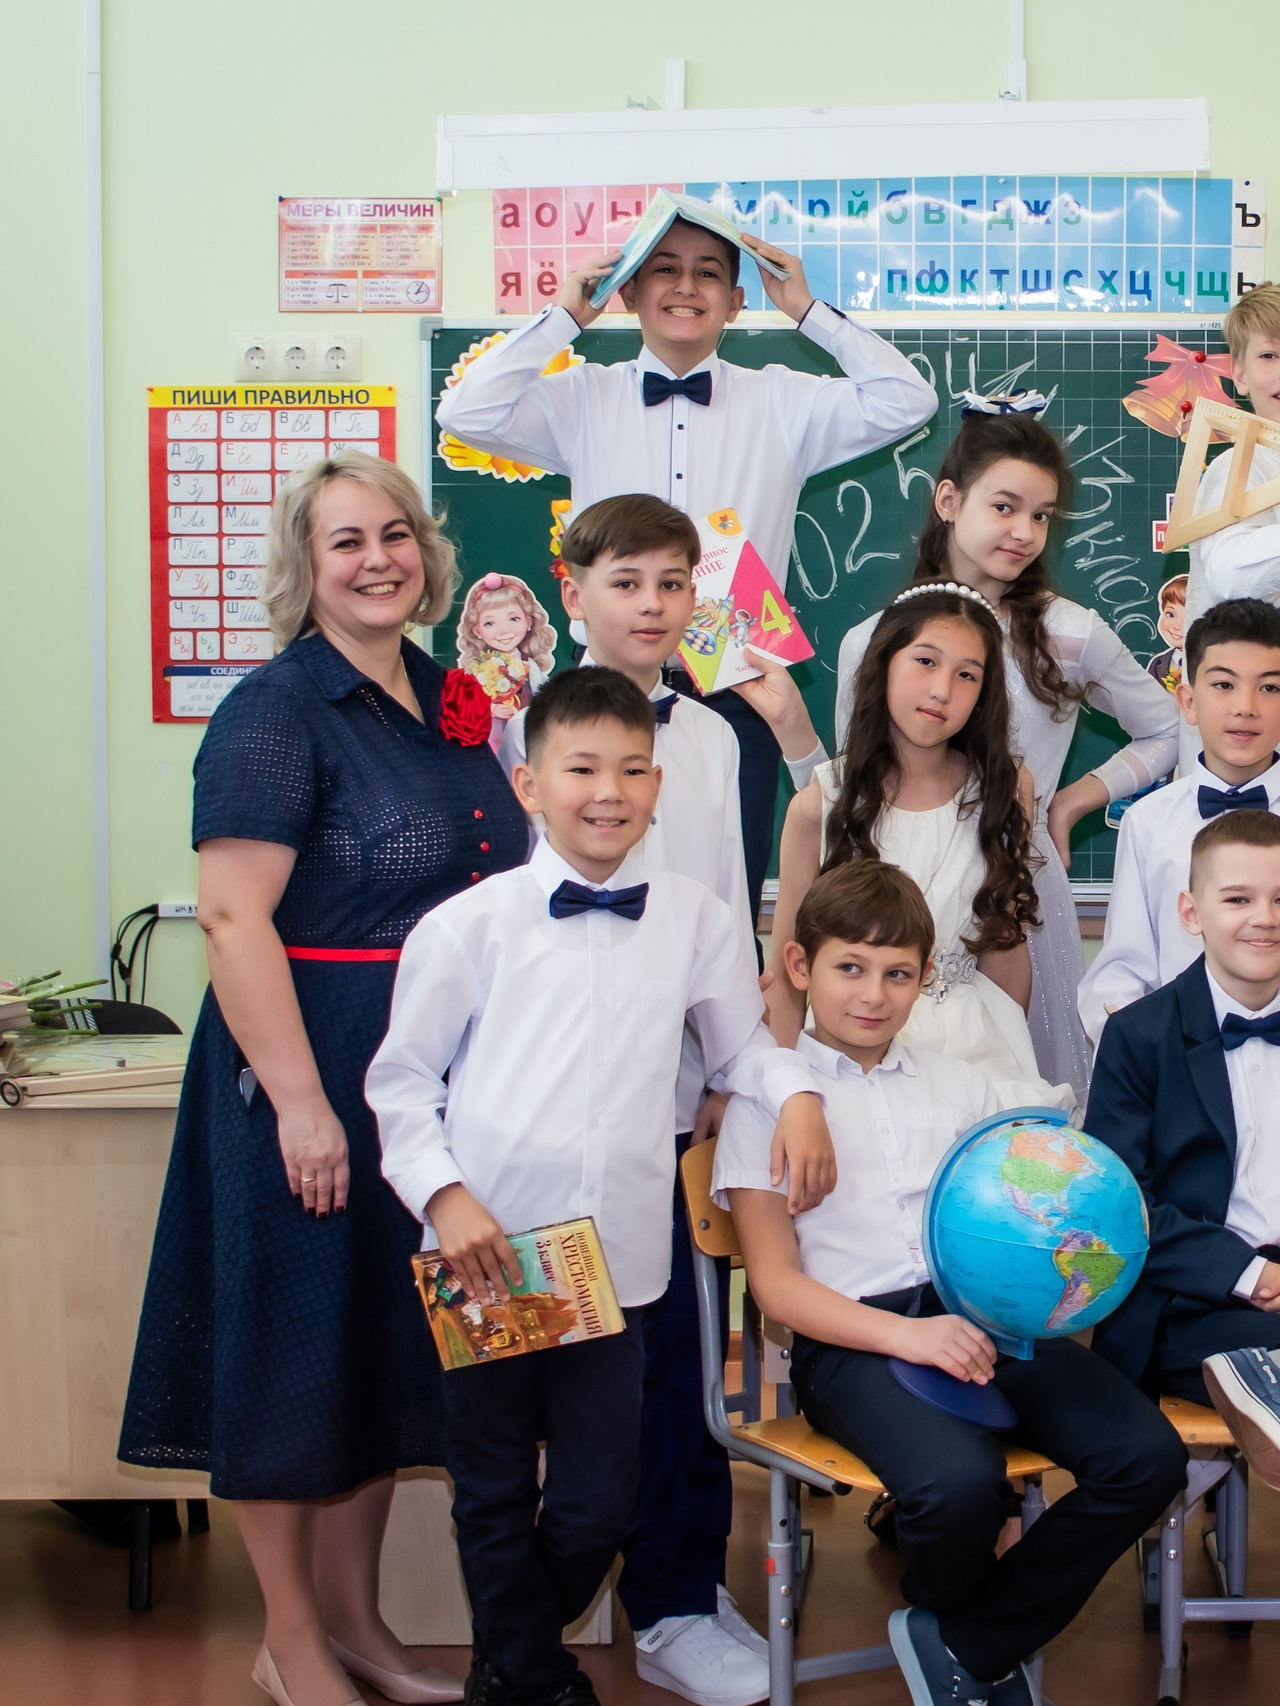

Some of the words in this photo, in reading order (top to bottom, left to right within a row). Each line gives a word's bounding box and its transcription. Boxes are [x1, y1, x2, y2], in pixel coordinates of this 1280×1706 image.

[286, 204, 340, 217] МЕРЫ
[500, 203, 520, 228] а
[535, 202, 557, 228] о
[575, 202, 595, 236] у
[808, 198, 830, 233] р
[885, 190, 908, 224] б
[924, 199, 946, 224] в
[961, 199, 976, 224] г
[501, 272, 522, 296] я
[537, 262, 557, 296] ё
[887, 269, 907, 293] п
[916, 260, 949, 296] ф
[960, 269, 978, 293] к
[1022, 269, 1051, 293] ш
[1097, 270, 1118, 294] х
[1130, 271, 1151, 301] ц
[1165, 271, 1184, 295] ч
[1197, 272, 1228, 302] щ
[172, 390, 236, 405] ПИШИ
[244, 389, 370, 404] ПРАВИЛЬНО
[760, 590, 792, 636] 4
[536, 1240, 551, 1249] 3
[576, 1232, 598, 1281] НОВЕЙШАЯ
[538, 1250, 556, 1282] класс
[560, 1234, 603, 1335] ХРЕСТОМАТИЯ
